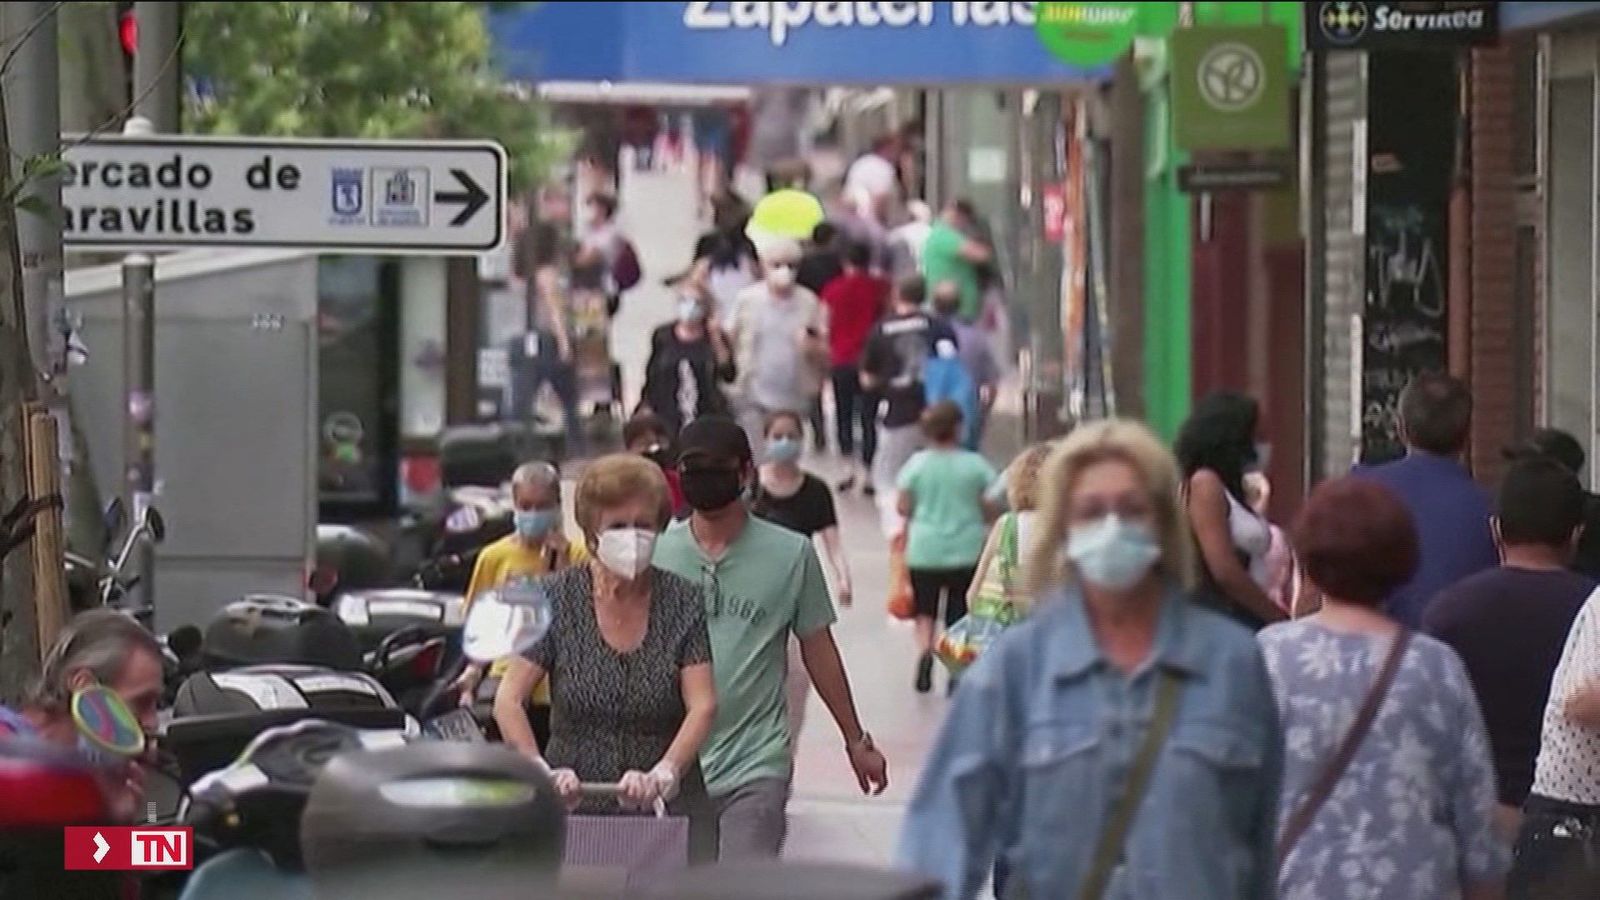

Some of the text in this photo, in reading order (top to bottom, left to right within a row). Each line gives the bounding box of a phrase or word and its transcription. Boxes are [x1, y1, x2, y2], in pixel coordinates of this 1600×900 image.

[62, 154, 301, 190] ercado de
[62, 199, 255, 234] aravillas
